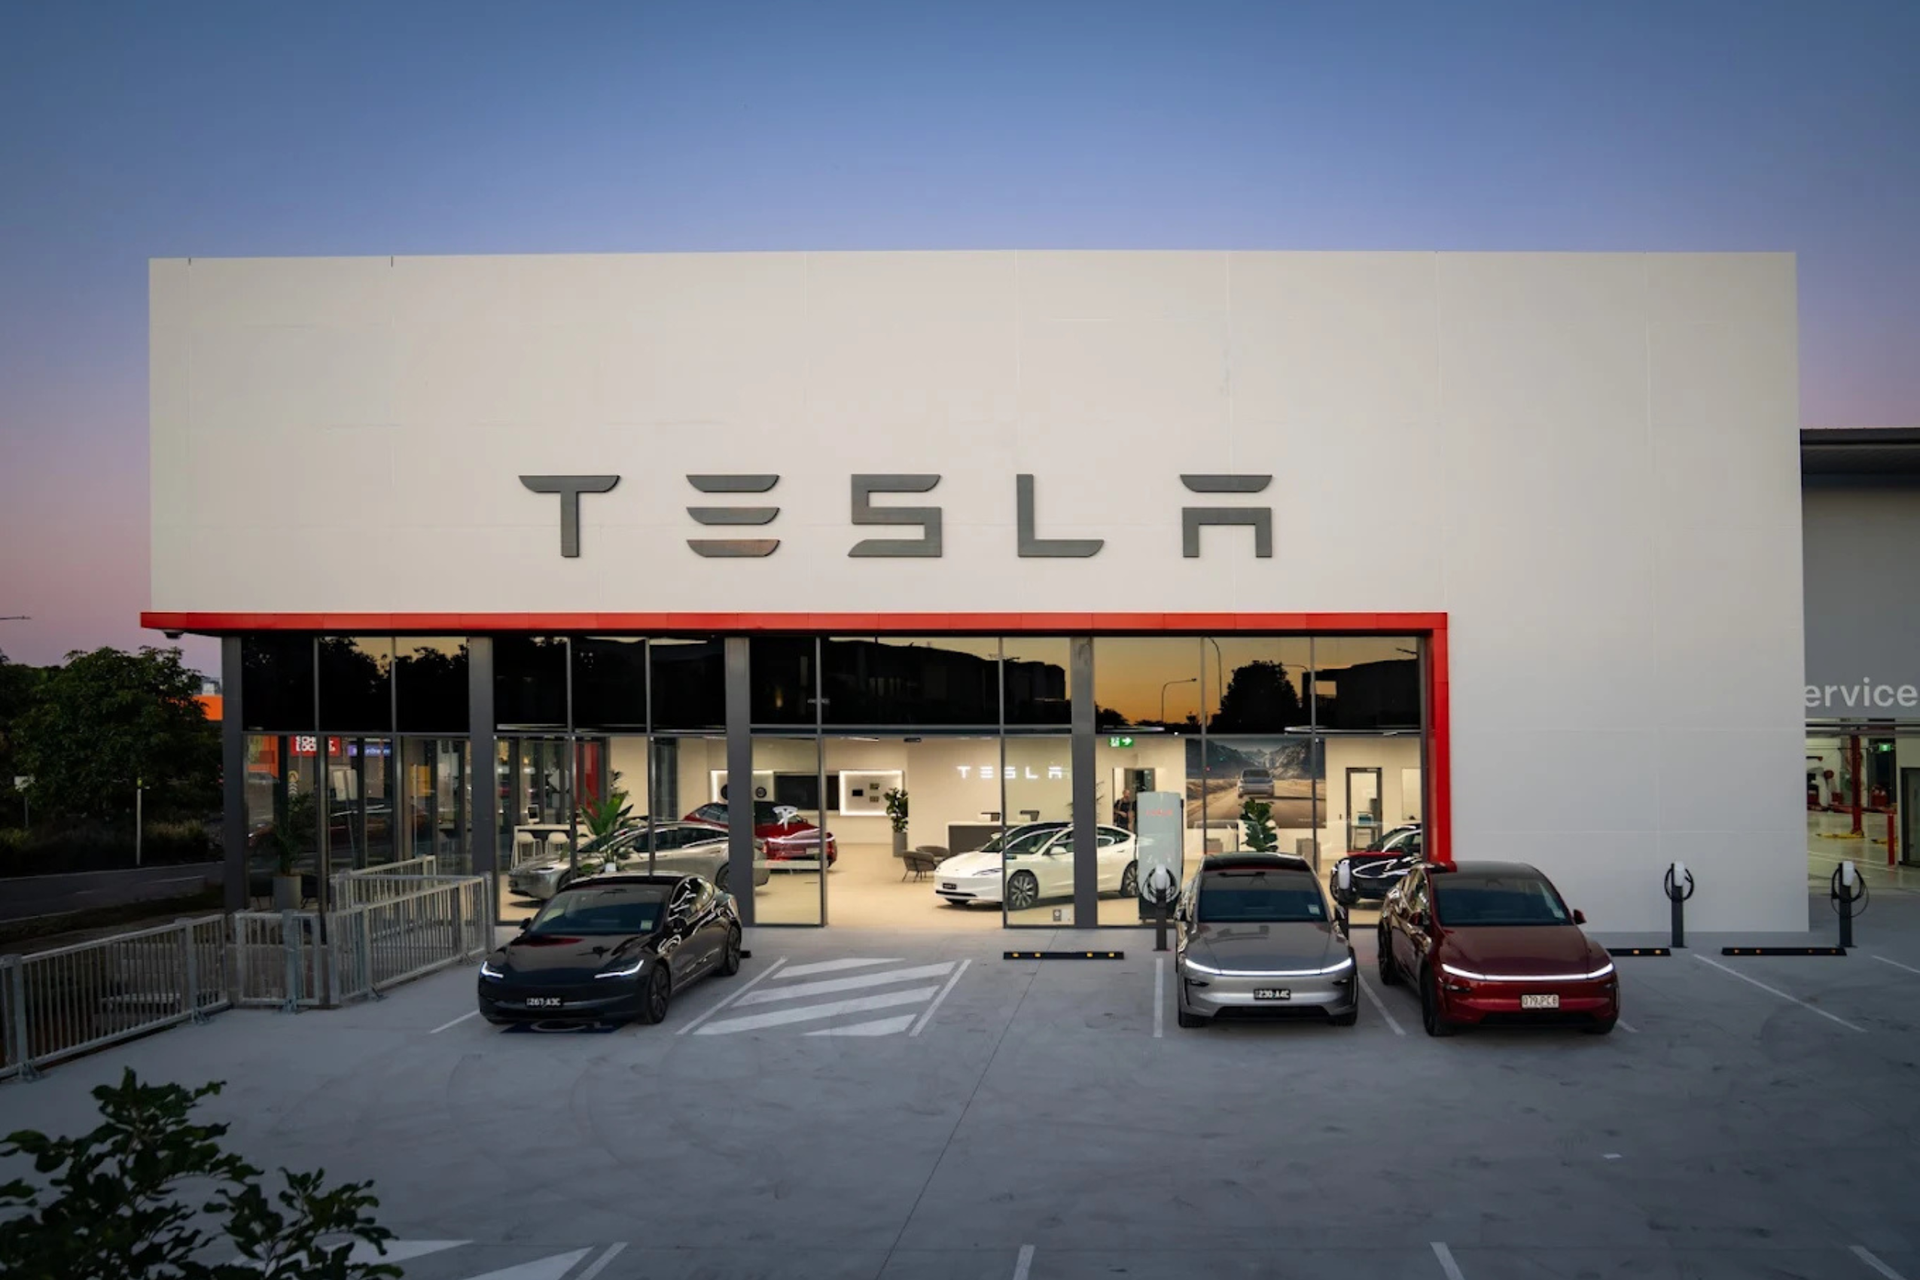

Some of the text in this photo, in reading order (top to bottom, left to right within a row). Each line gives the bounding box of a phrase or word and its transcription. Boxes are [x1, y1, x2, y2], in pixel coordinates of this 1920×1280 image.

[518, 474, 1274, 559] TESLA
[1805, 676, 1919, 707] ervice
[956, 765, 1063, 779] TESLA
